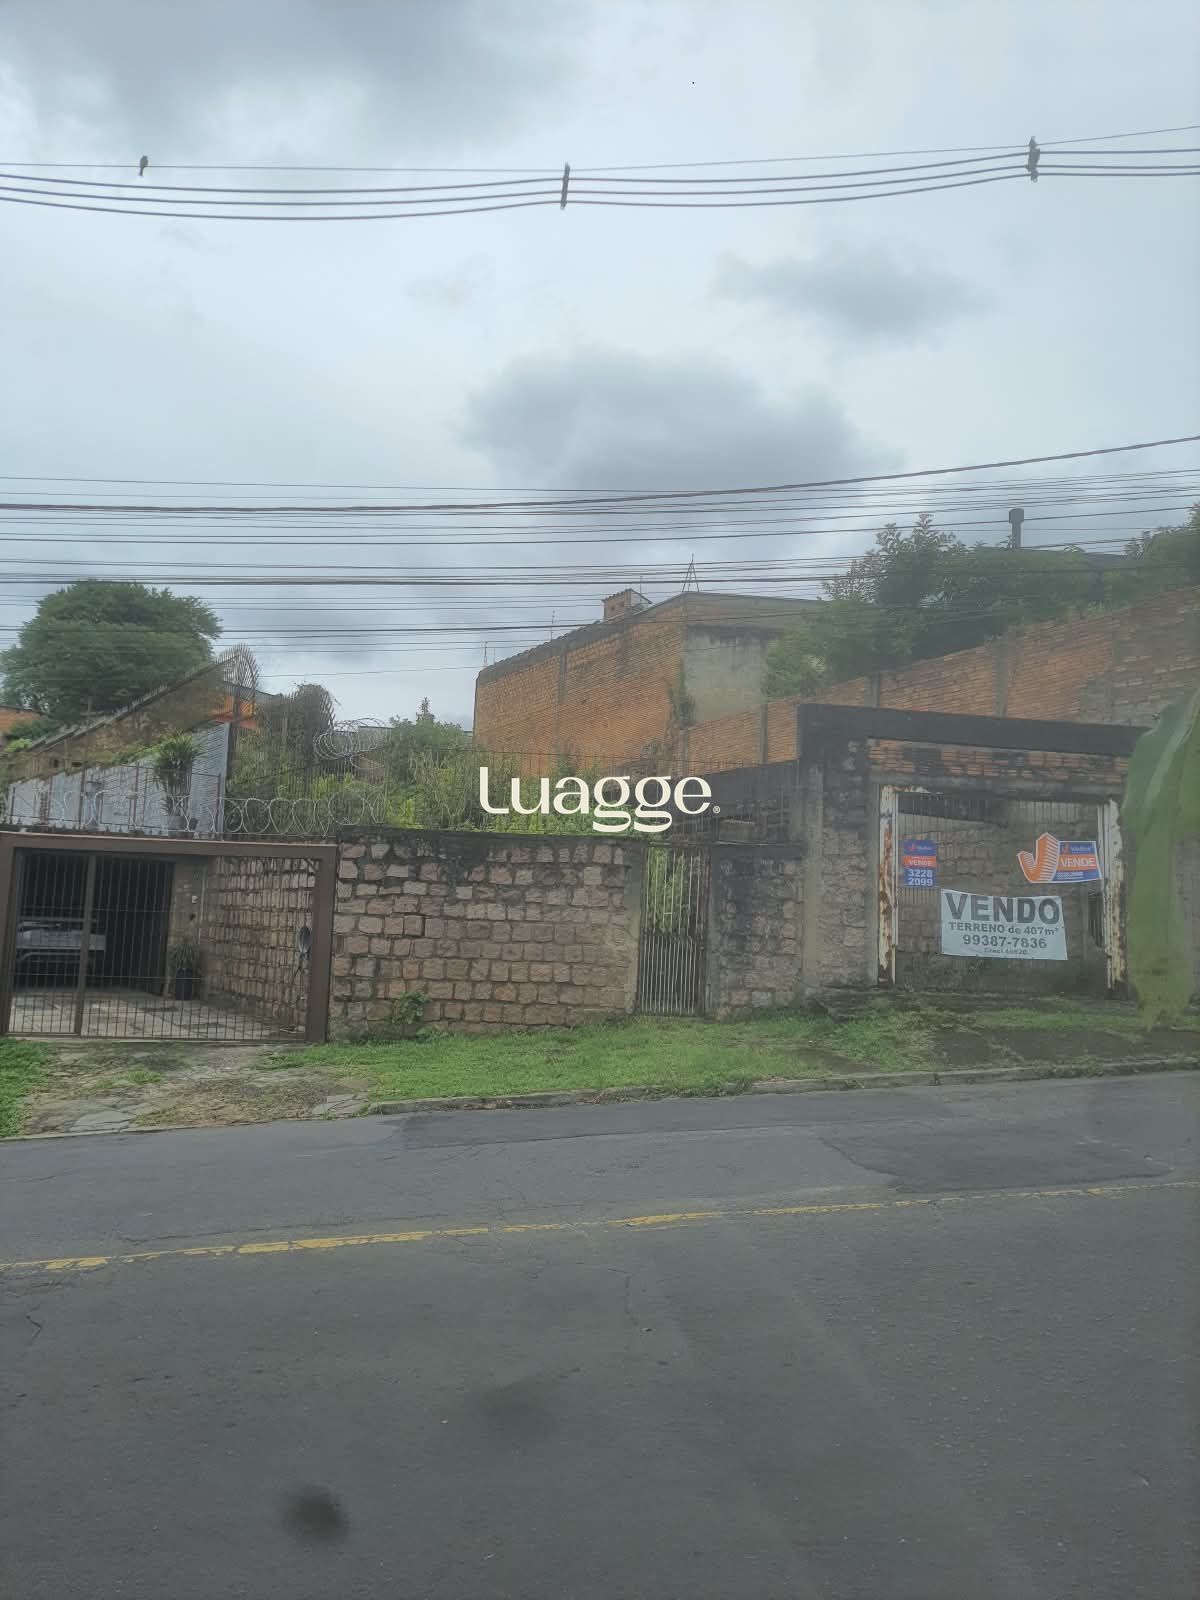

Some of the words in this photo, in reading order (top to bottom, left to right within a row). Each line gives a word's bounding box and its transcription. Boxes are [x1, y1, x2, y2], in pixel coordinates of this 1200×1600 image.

[1060, 857, 1097, 867] VENDE
[907, 869, 933, 878] 3228
[908, 878, 933, 886] 2099
[944, 892, 1060, 925] VENDO
[948, 921, 1005, 934] TERRENO
[1007, 925, 1022, 935] de
[962, 934, 1048, 949] 99387-7836
